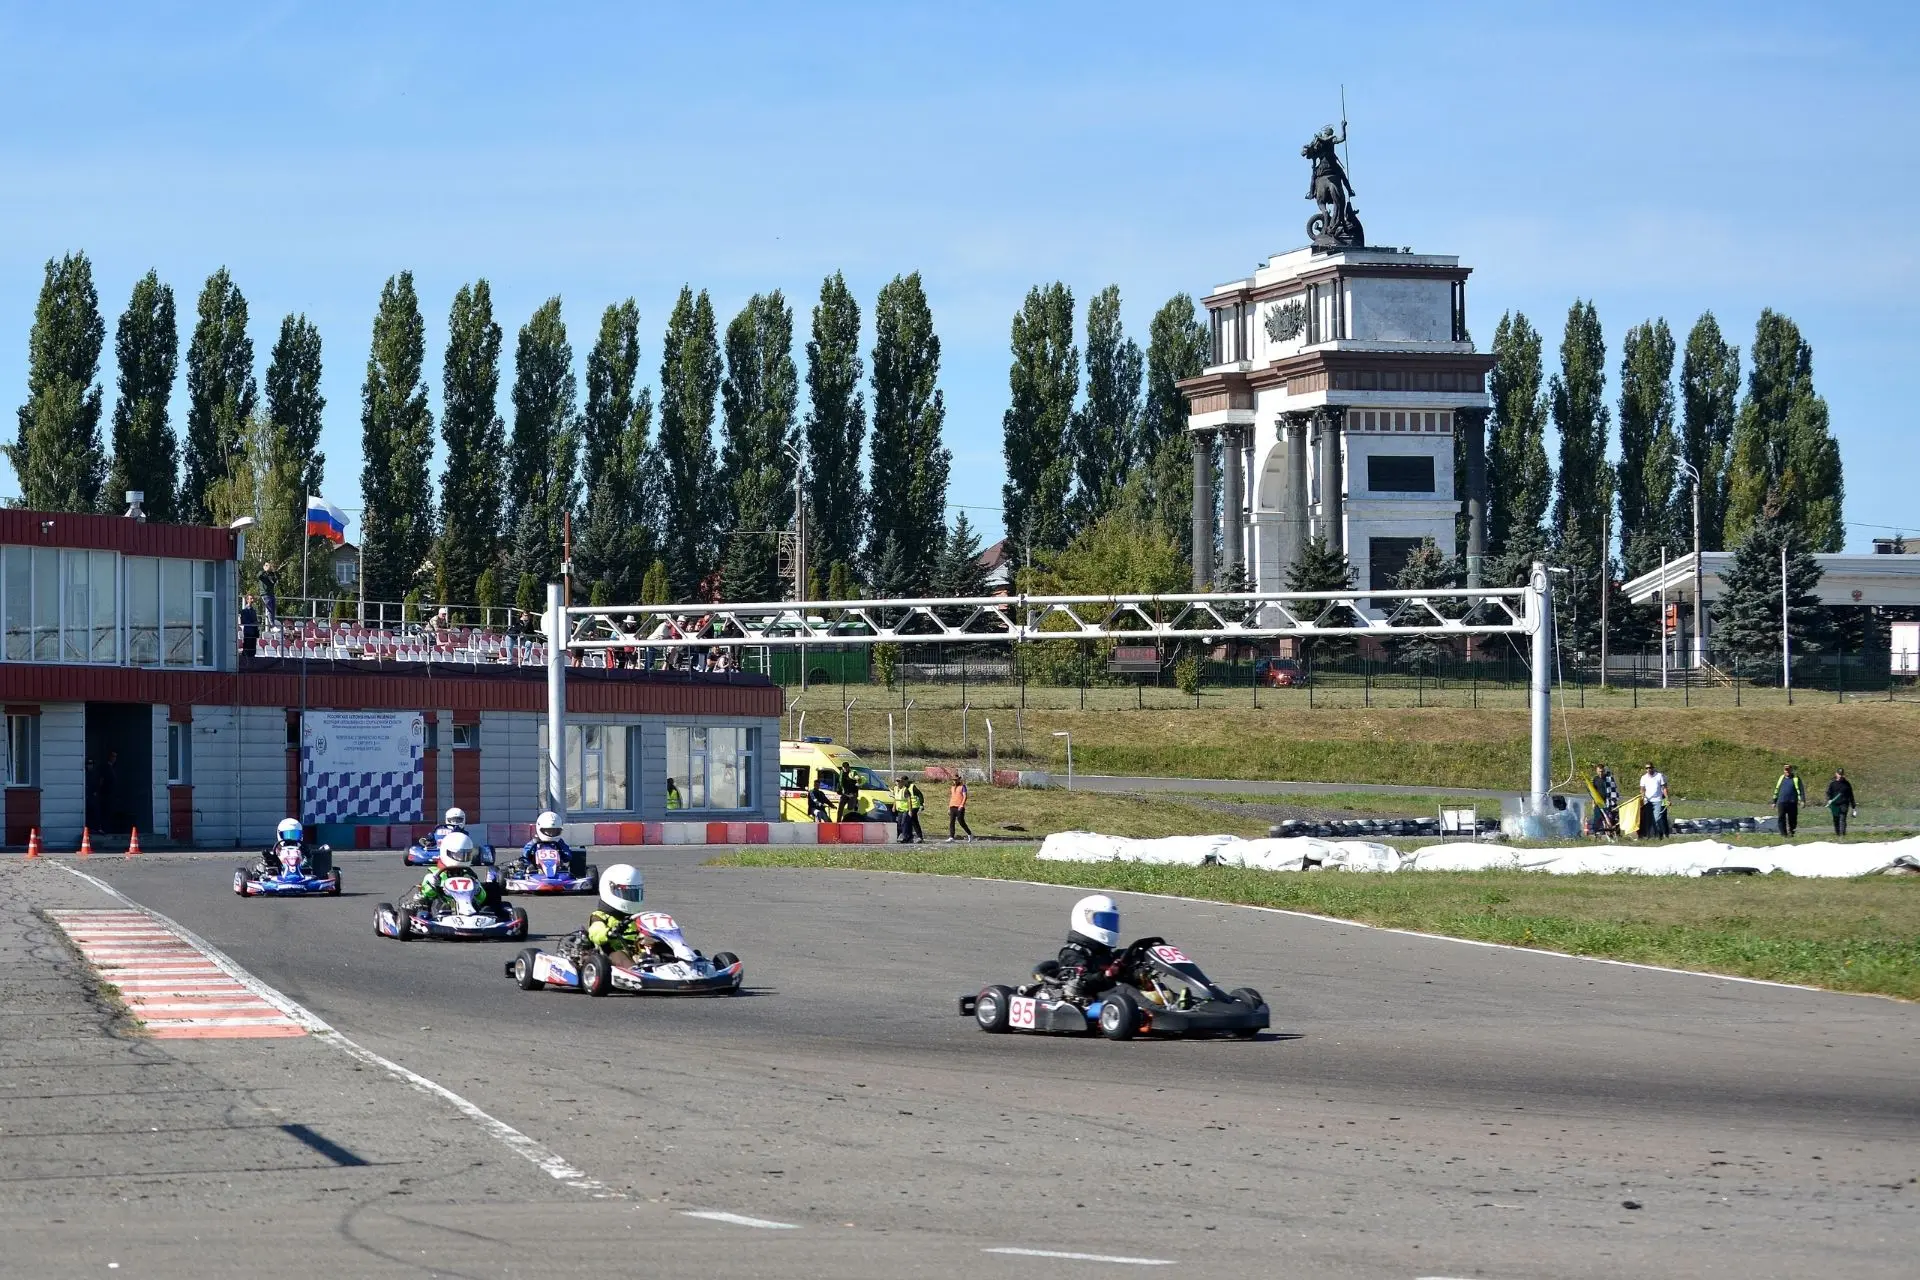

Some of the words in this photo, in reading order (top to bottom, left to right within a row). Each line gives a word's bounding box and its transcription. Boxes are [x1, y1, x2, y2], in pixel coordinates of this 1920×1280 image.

[540, 850, 557, 859] 55
[450, 880, 471, 890] 17
[644, 916, 673, 928] 77
[1158, 948, 1188, 961] 95
[1012, 1001, 1033, 1024] 95
